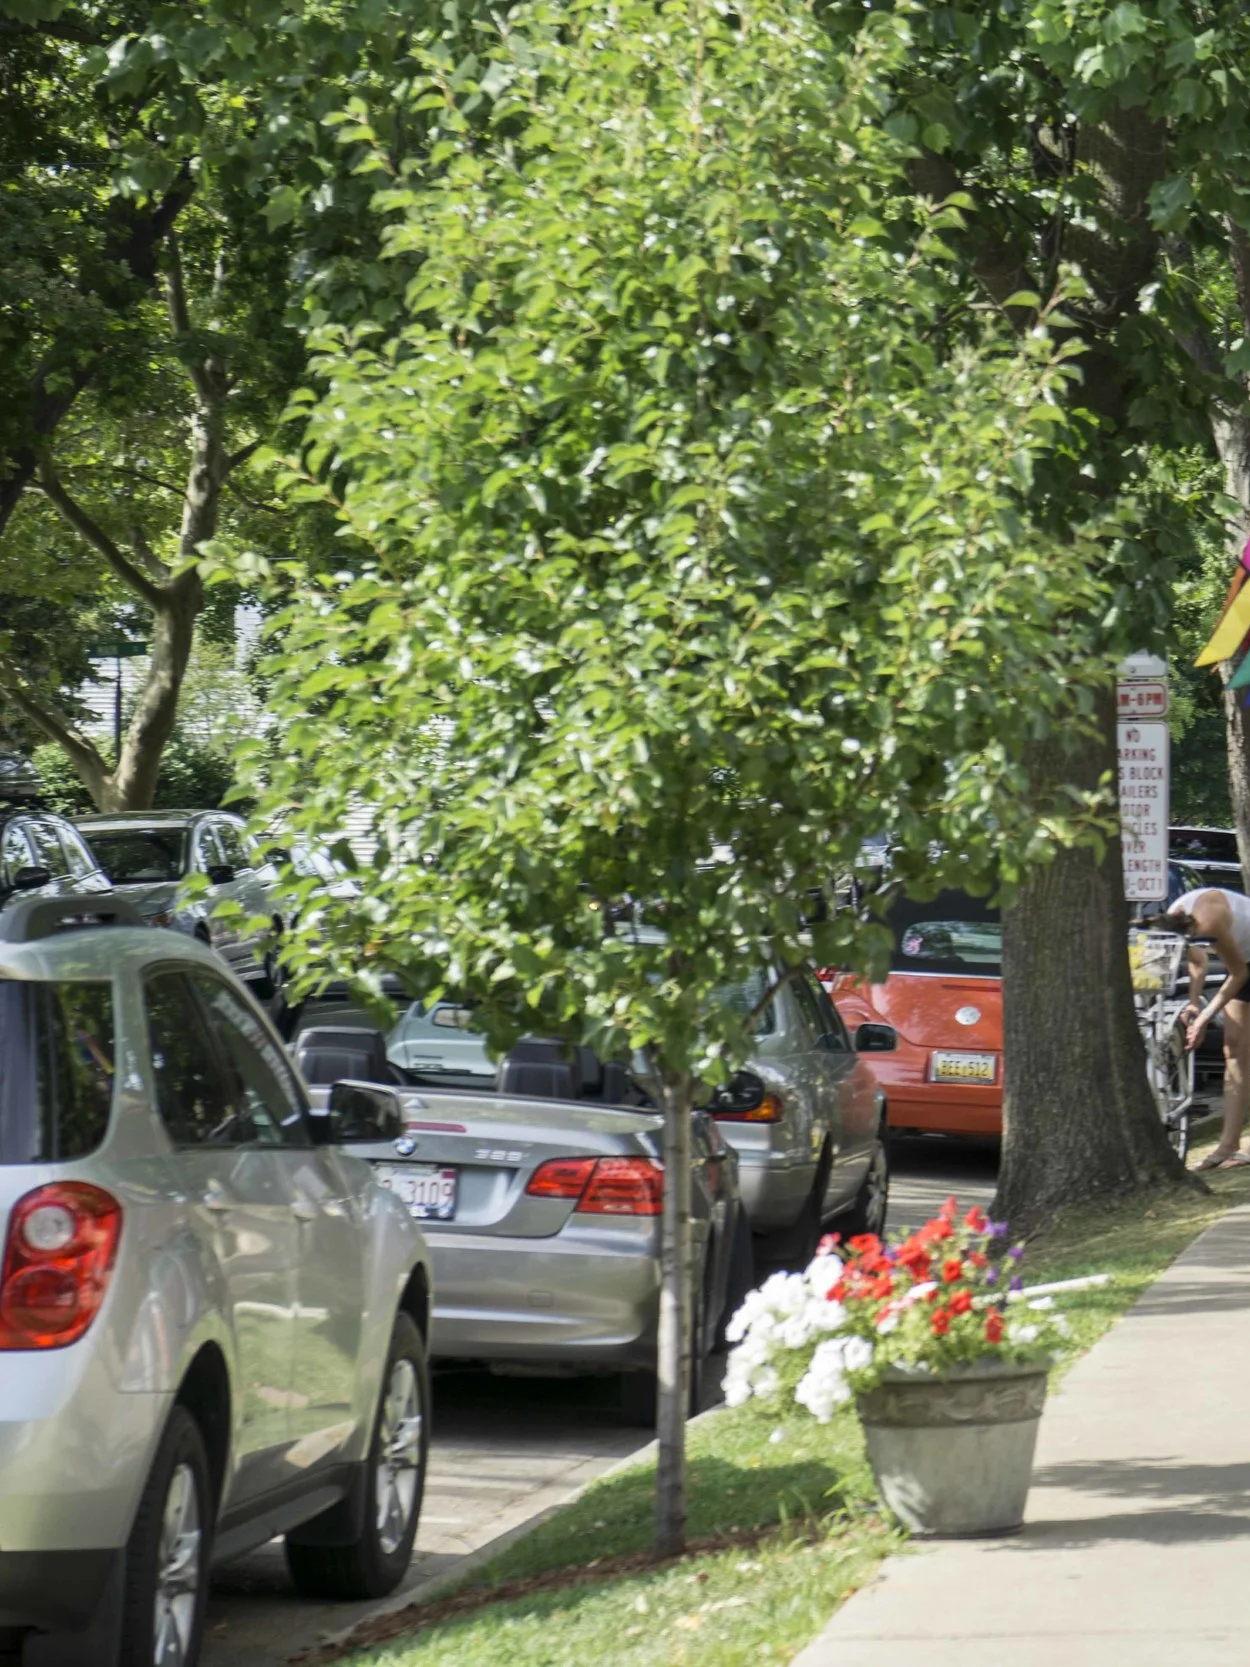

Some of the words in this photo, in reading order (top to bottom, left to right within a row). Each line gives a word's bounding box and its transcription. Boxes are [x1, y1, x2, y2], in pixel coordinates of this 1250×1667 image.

[1117, 692, 1163, 706] M-6PM
[1126, 730, 1141, 743] NO
[1117, 748, 1156, 761] ARKING
[1129, 767, 1164, 780] BLOCK
[1121, 785, 1158, 798] AILERS
[1121, 804, 1150, 817] OTOR
[1122, 841, 1146, 853] VER
